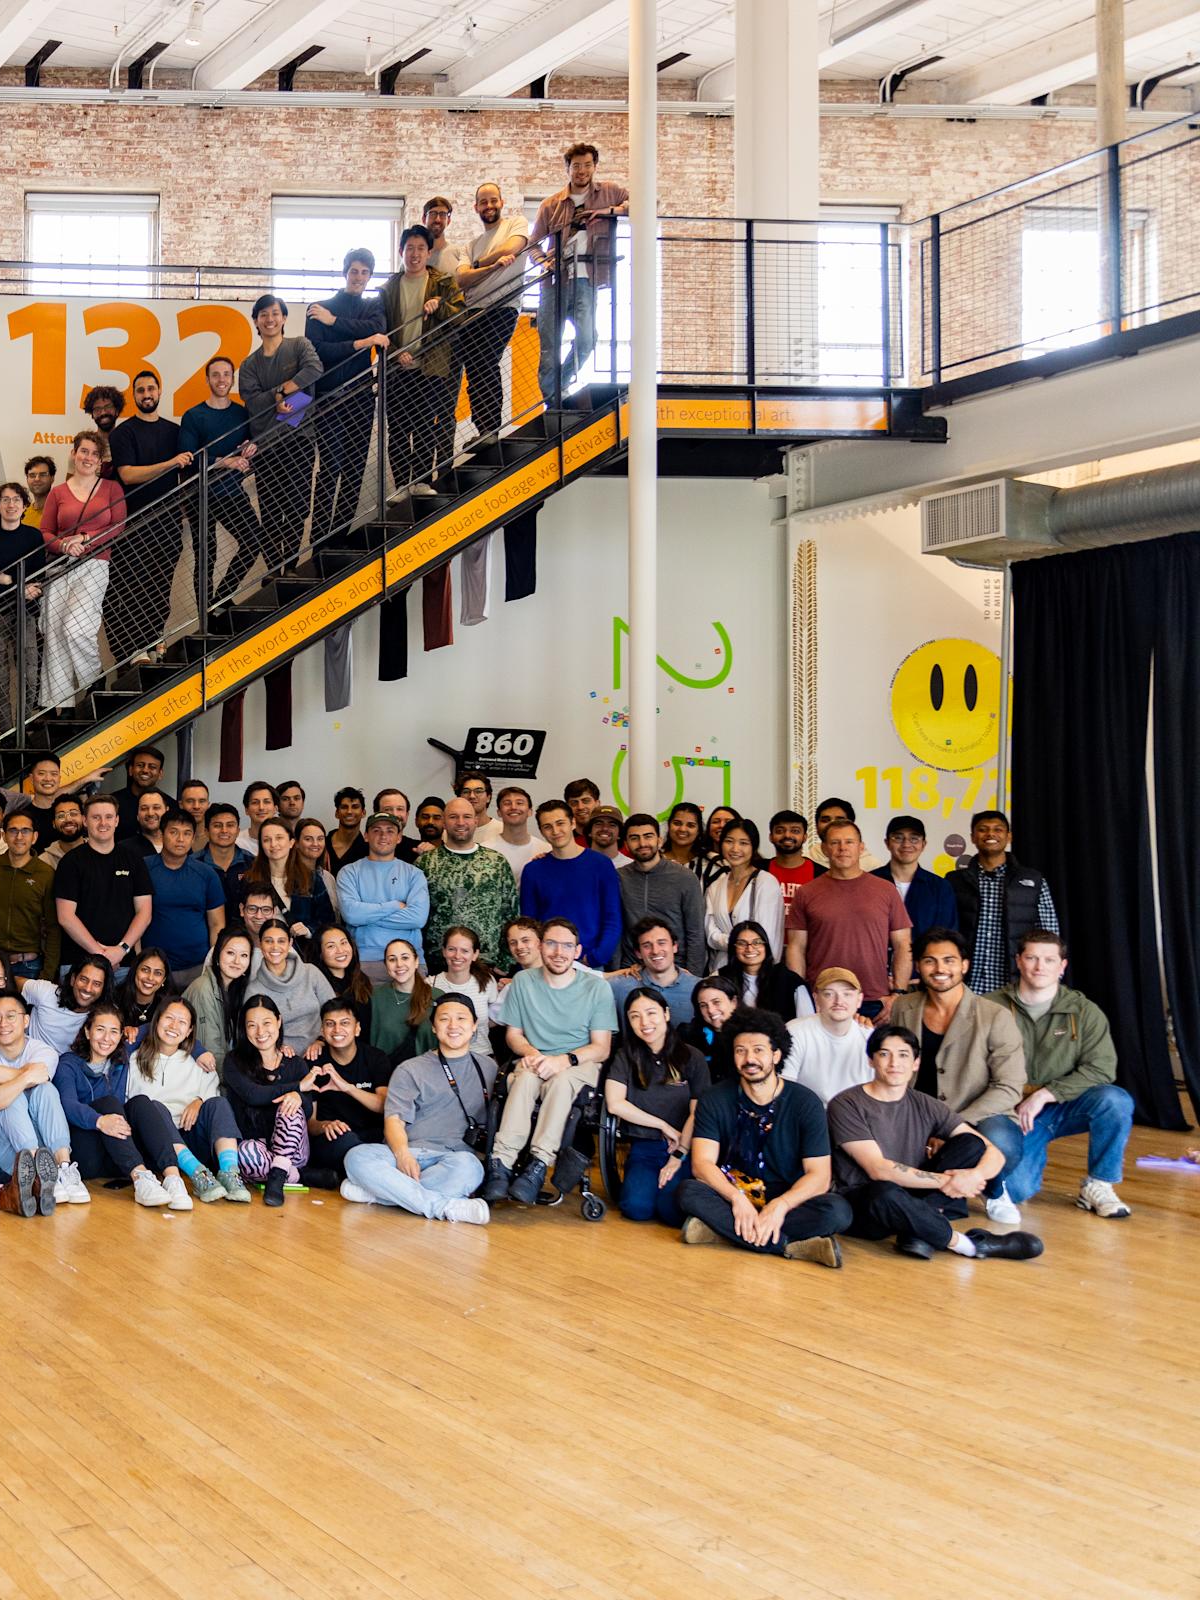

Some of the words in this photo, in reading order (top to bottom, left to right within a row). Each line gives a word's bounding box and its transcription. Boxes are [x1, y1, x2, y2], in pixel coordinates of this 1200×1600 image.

[657, 406, 675, 421] ith
[33, 431, 74, 444] Atten
[62, 759, 84, 777] we
[86, 735, 128, 764] share.
[127, 711, 159, 735] Year
[163, 690, 193, 716] after
[228, 653, 252, 673] the
[253, 627, 289, 657] word
[290, 597, 348, 635] spreads,
[413, 535, 438, 557] the
[440, 510, 485, 541] square
[484, 475, 536, 513] footage
[537, 462, 559, 480] we
[563, 426, 615, 465] activate
[475, 732, 534, 756] 860
